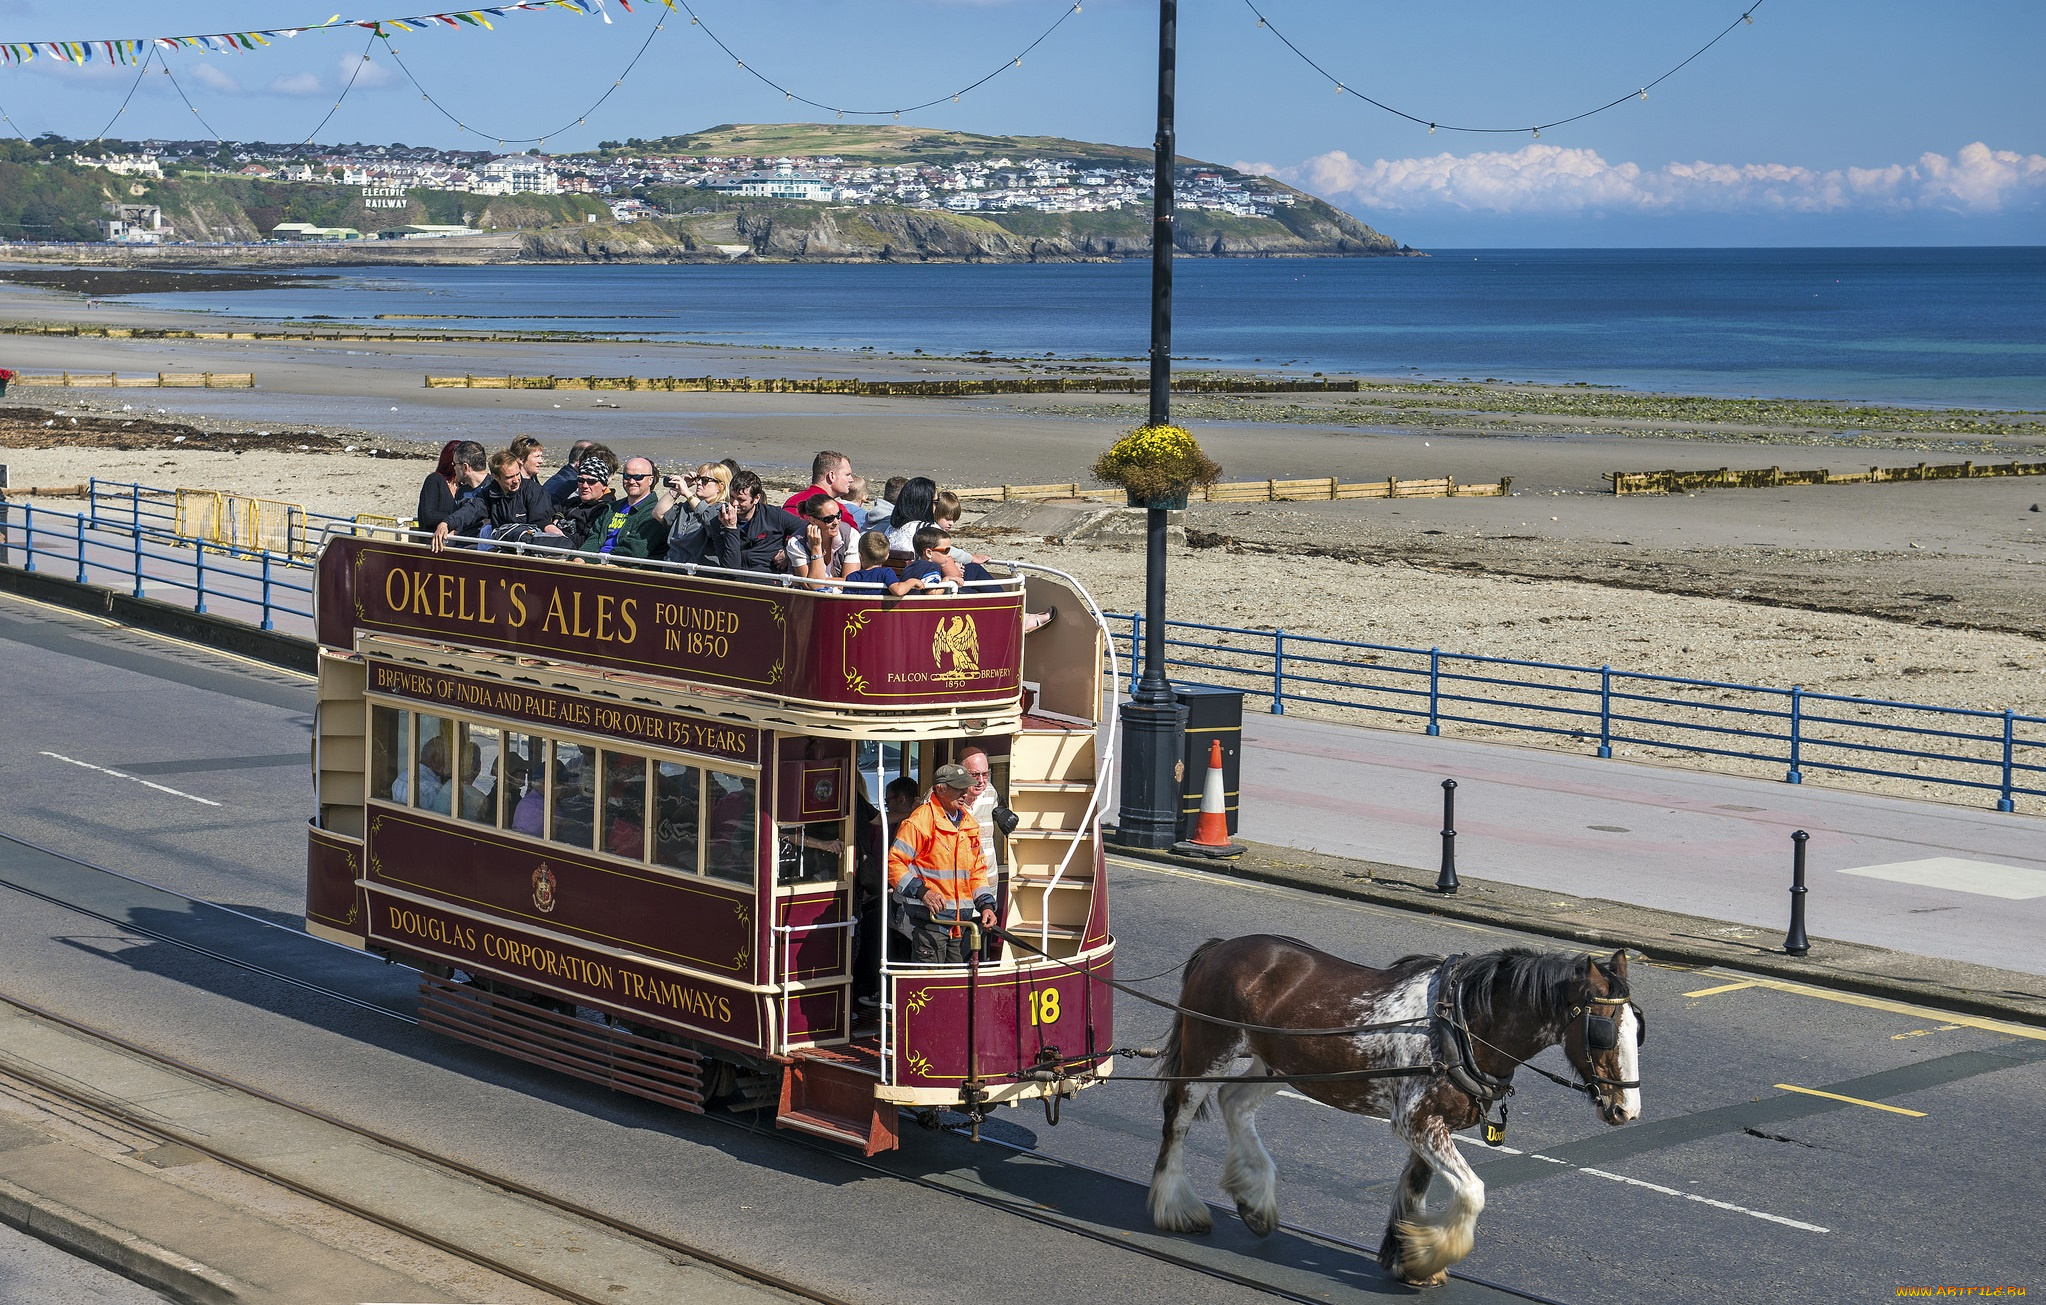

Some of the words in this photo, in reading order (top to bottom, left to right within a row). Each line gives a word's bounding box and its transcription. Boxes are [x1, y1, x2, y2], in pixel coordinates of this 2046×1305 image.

[362, 188, 405, 197] ELECTRIC
[365, 199, 407, 208] RAILWAY
[385, 568, 527, 627] OKELL'S
[542, 586, 638, 644] ALES
[655, 602, 740, 635] FOUNDED
[665, 629, 682, 651] IN
[686, 634, 730, 659] 1850
[887, 672, 928, 683] FALCON
[981, 667, 1012, 679] BREWERY
[945, 680, 966, 688] 1850
[378, 668, 433, 695] BREWERS
[437, 679, 454, 699] OF
[457, 683, 492, 707] INDIA
[494, 691, 522, 713] AND
[524, 696, 557, 718] PALE
[559, 704, 591, 725] ALES
[594, 708, 622, 731] FOR
[624, 714, 665, 739] OVER
[667, 721, 691, 746] 135
[694, 726, 746, 753] YEARS
[389, 906, 477, 951] DOUGLAS
[483, 933, 614, 990] CORPORATION
[618, 969, 732, 1023] TRAMWAYS
[1028, 987, 1061, 1026] 18
